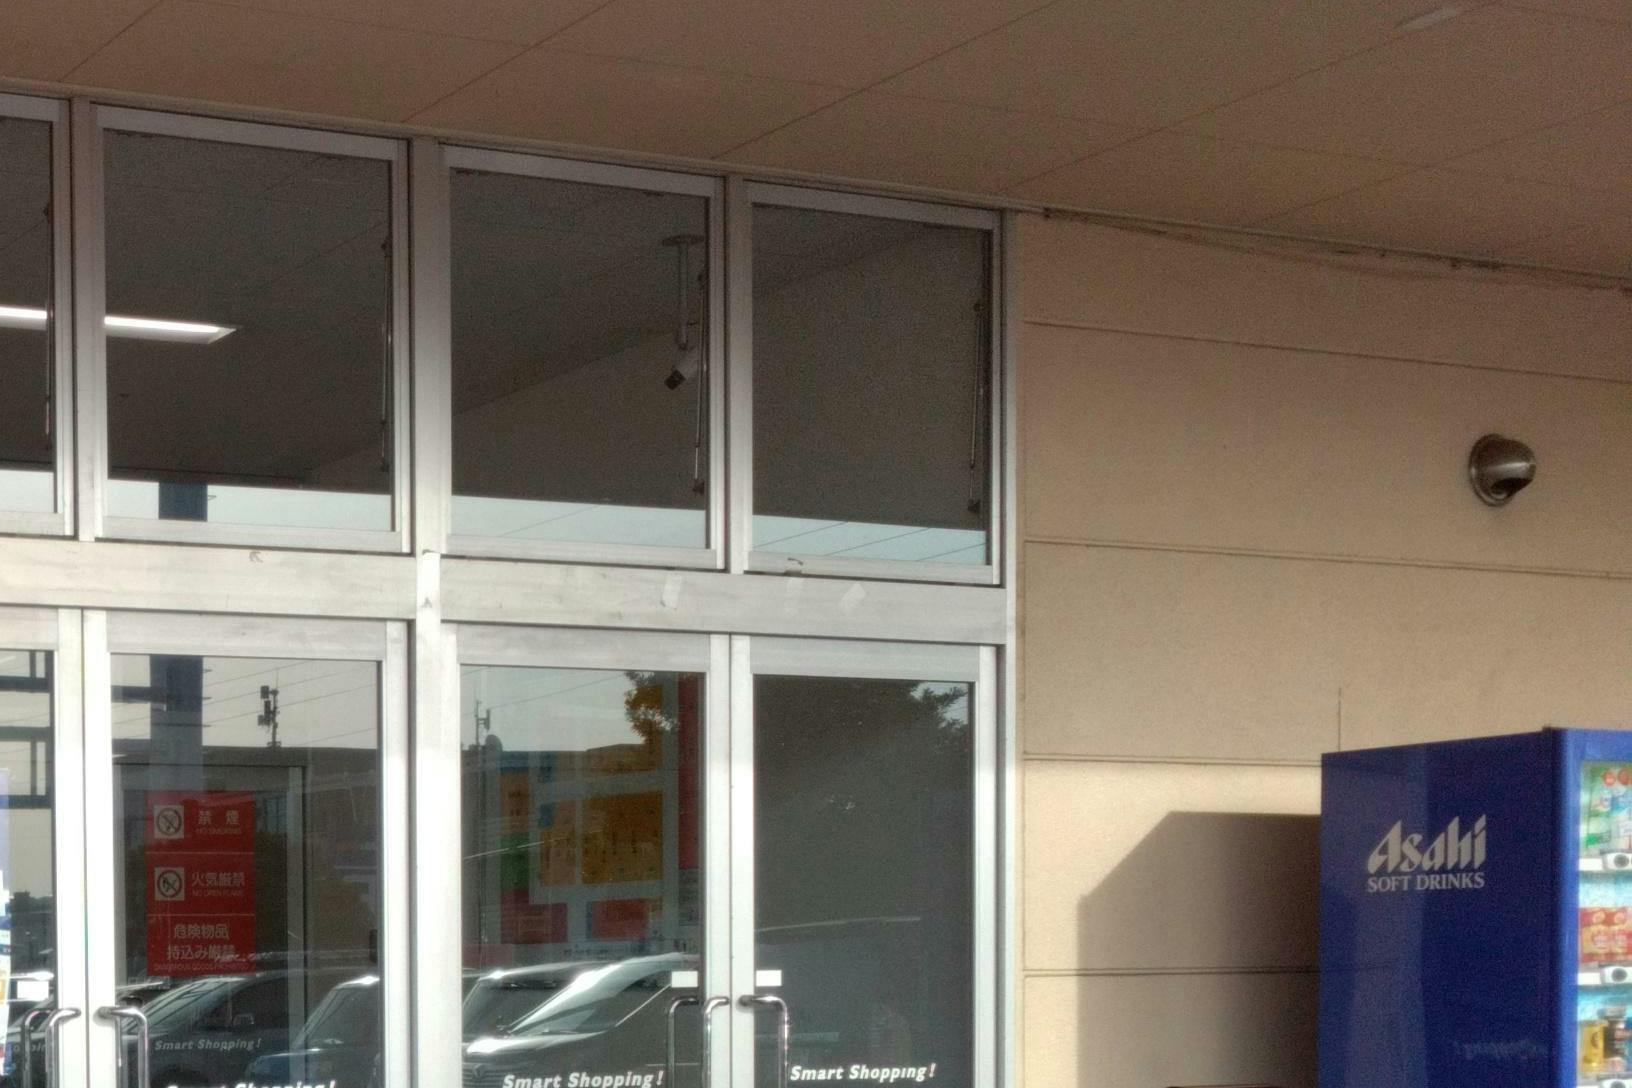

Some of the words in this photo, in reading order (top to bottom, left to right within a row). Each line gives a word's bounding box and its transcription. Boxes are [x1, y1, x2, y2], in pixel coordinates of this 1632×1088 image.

[1368, 814, 1487, 874] Asahi
[191, 872, 246, 887] 火気厳禁
[1367, 875, 1411, 892] SOFT
[1417, 872, 1486, 891] DRINKS
[790, 1065, 845, 1082] Smart
[849, 1063, 937, 1081] Shopping!
